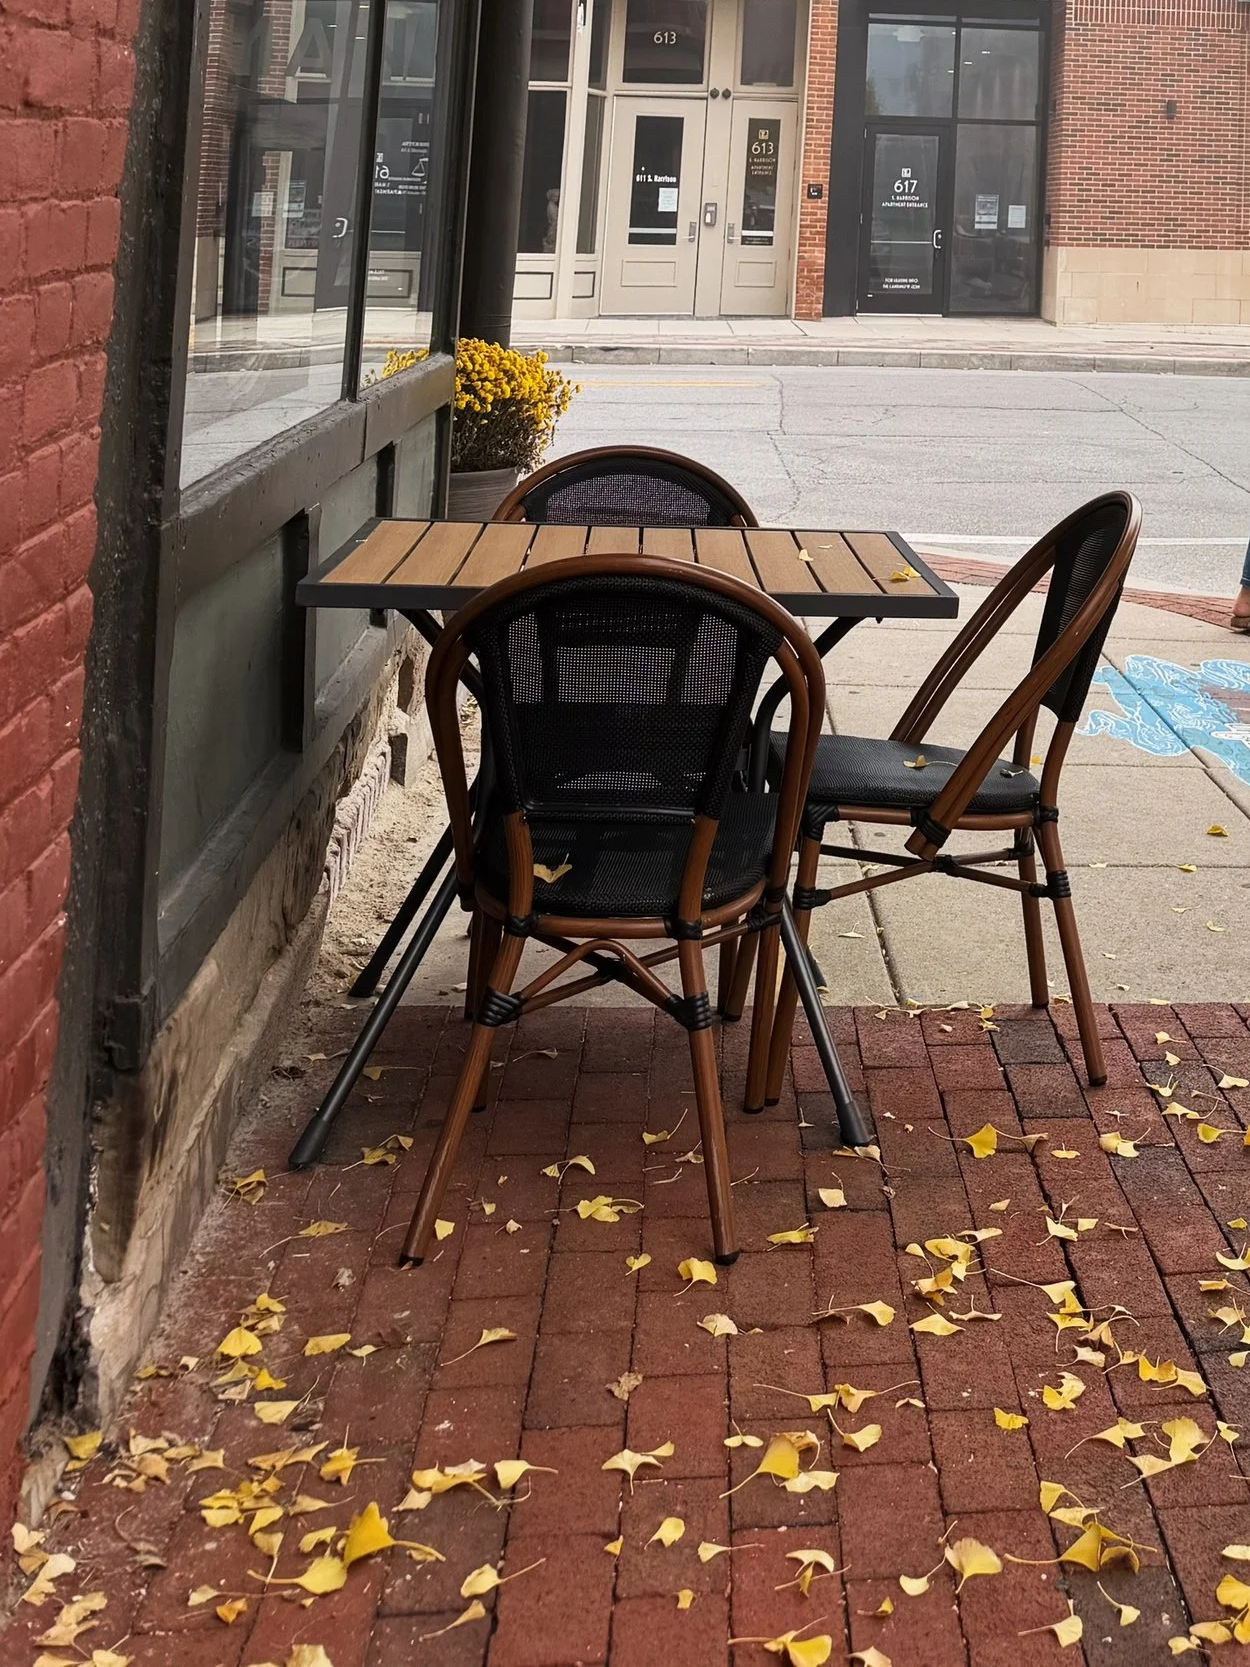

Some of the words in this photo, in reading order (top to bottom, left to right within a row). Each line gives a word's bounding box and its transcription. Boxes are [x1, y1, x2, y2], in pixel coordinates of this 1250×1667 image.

[653, 31, 677, 44] 613
[751, 142, 774, 155] 613
[636, 174, 646, 182] 611
[894, 179, 918, 194] 617
